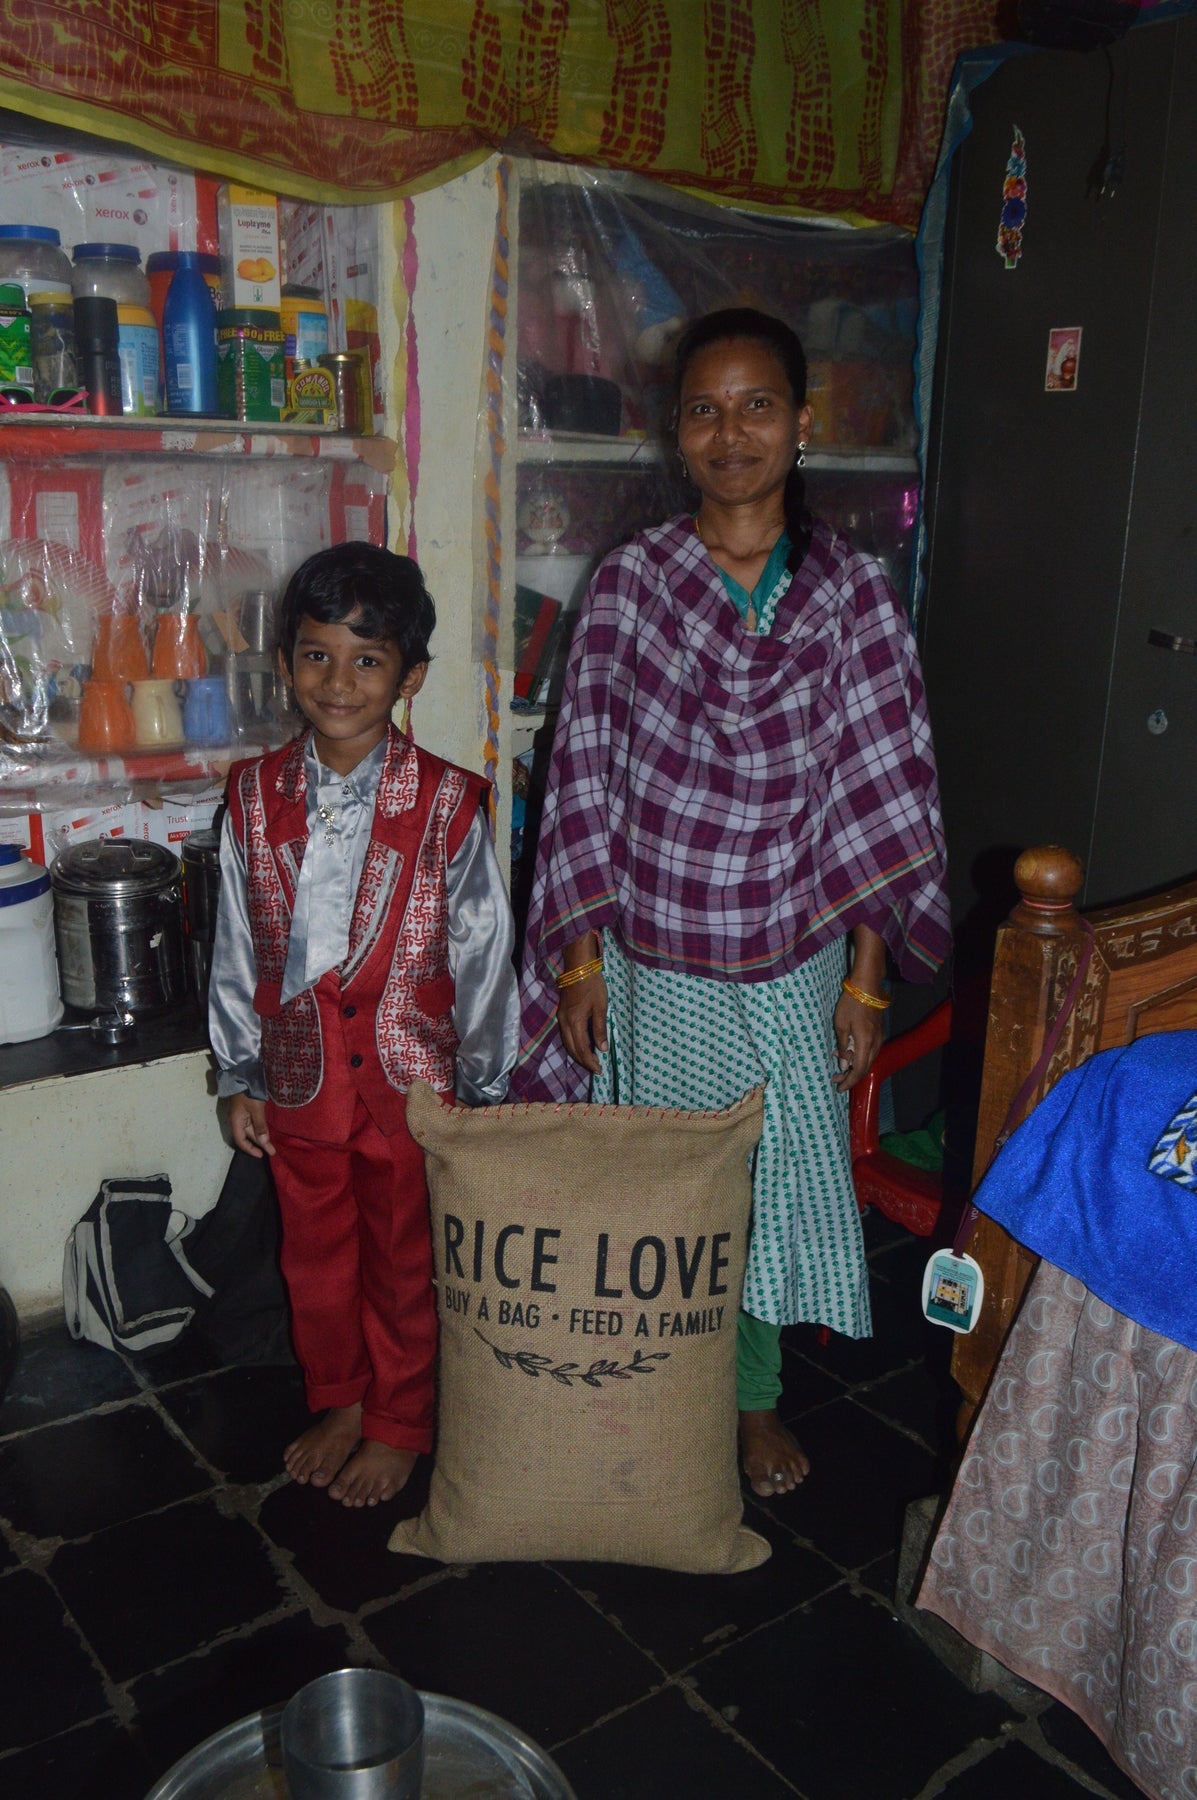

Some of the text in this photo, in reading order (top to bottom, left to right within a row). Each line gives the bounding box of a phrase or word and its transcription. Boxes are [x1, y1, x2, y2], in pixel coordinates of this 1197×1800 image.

[17, 160, 40, 171] xerox
[95, 207, 130, 220] xerox
[264, 330, 286, 342] FREE
[101, 804, 122, 816] xerox
[167, 815, 188, 825] Trust
[444, 1213, 731, 1300] RICE LOVE
[445, 1285, 725, 1337] BUY A BAG FEED A FAMILY
